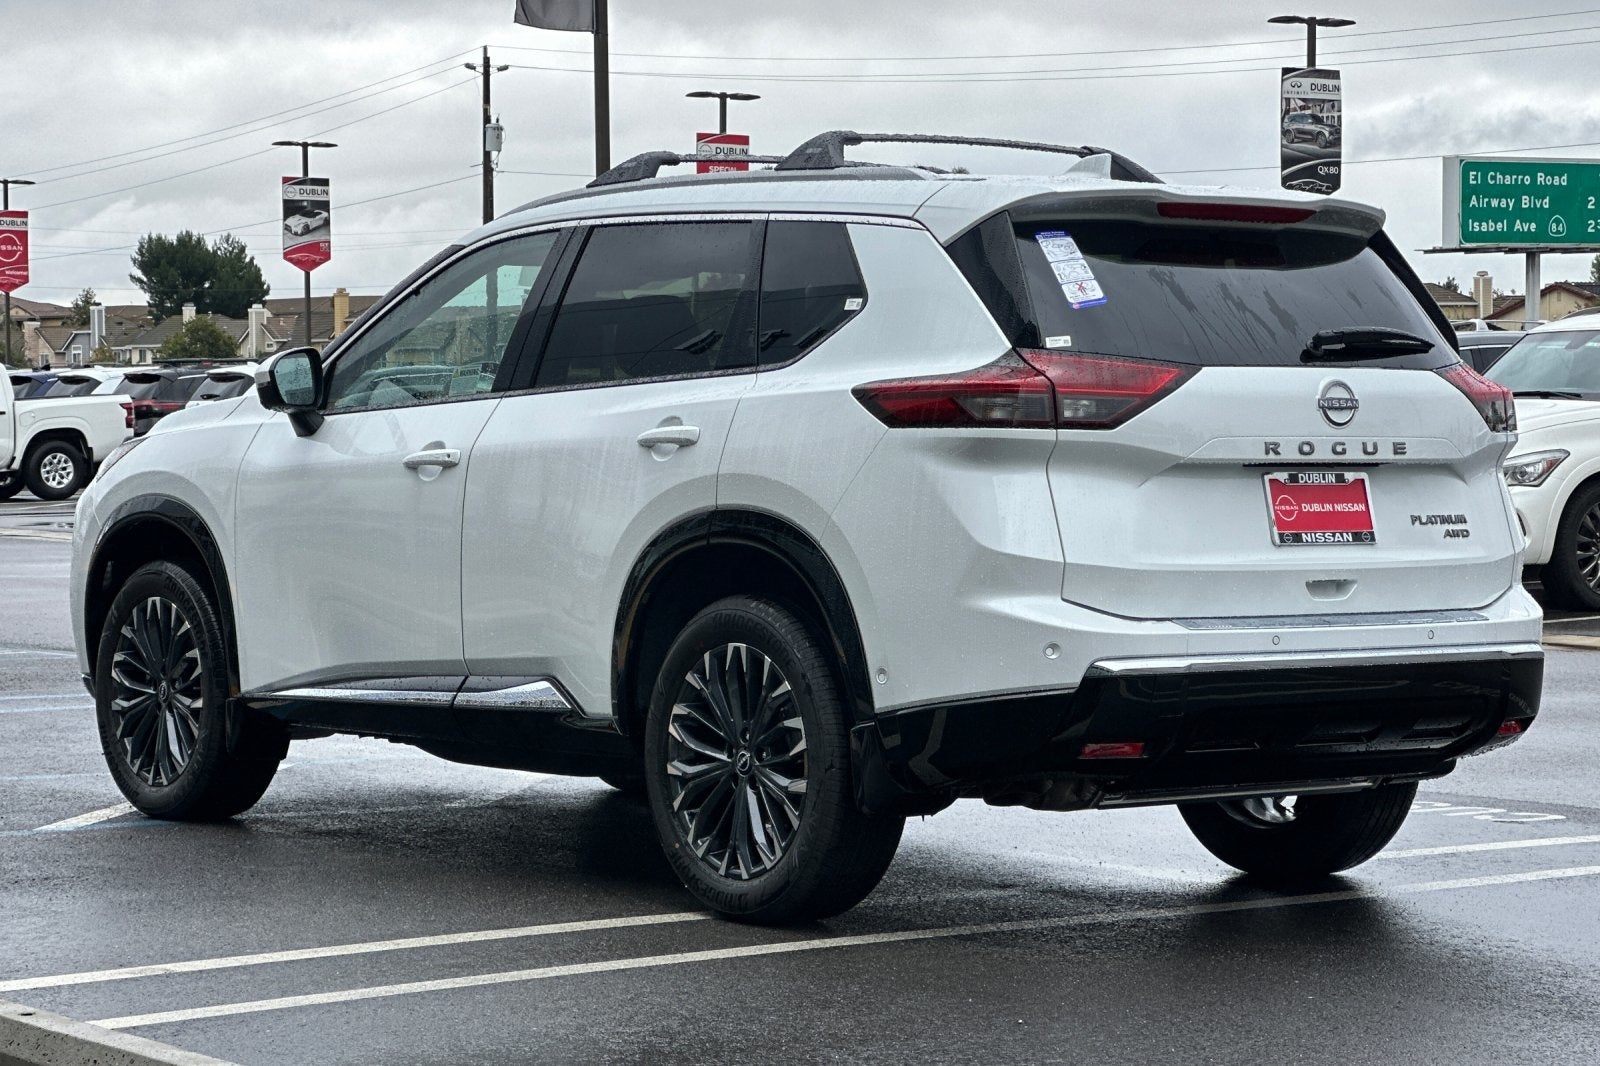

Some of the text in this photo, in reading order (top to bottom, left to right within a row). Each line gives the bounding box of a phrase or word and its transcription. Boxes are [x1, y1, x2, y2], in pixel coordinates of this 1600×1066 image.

[1310, 83, 1340, 93] DUBLIN
[715, 147, 748, 155] DUBLIN
[1469, 171, 1568, 186] El Charro Road
[299, 188, 329, 196] DUBLIN
[1469, 195, 1515, 211] Airway
[1521, 195, 1549, 209] Blvd
[0, 219, 28, 227] DUBLIN
[1468, 219, 1507, 232] Isabel
[1514, 219, 1537, 232] Ave
[1551, 223, 1563, 233] 84
[1319, 399, 1359, 408] NISSAN
[1264, 441, 1408, 456] ROGUE
[1298, 473, 1336, 484] DUBLIN
[1301, 503, 1366, 512] DUBLIN NISSAN
[1410, 514, 1468, 526] PLATINUM
[1302, 532, 1353, 542] NISSAN
[1443, 528, 1470, 539] AWD
